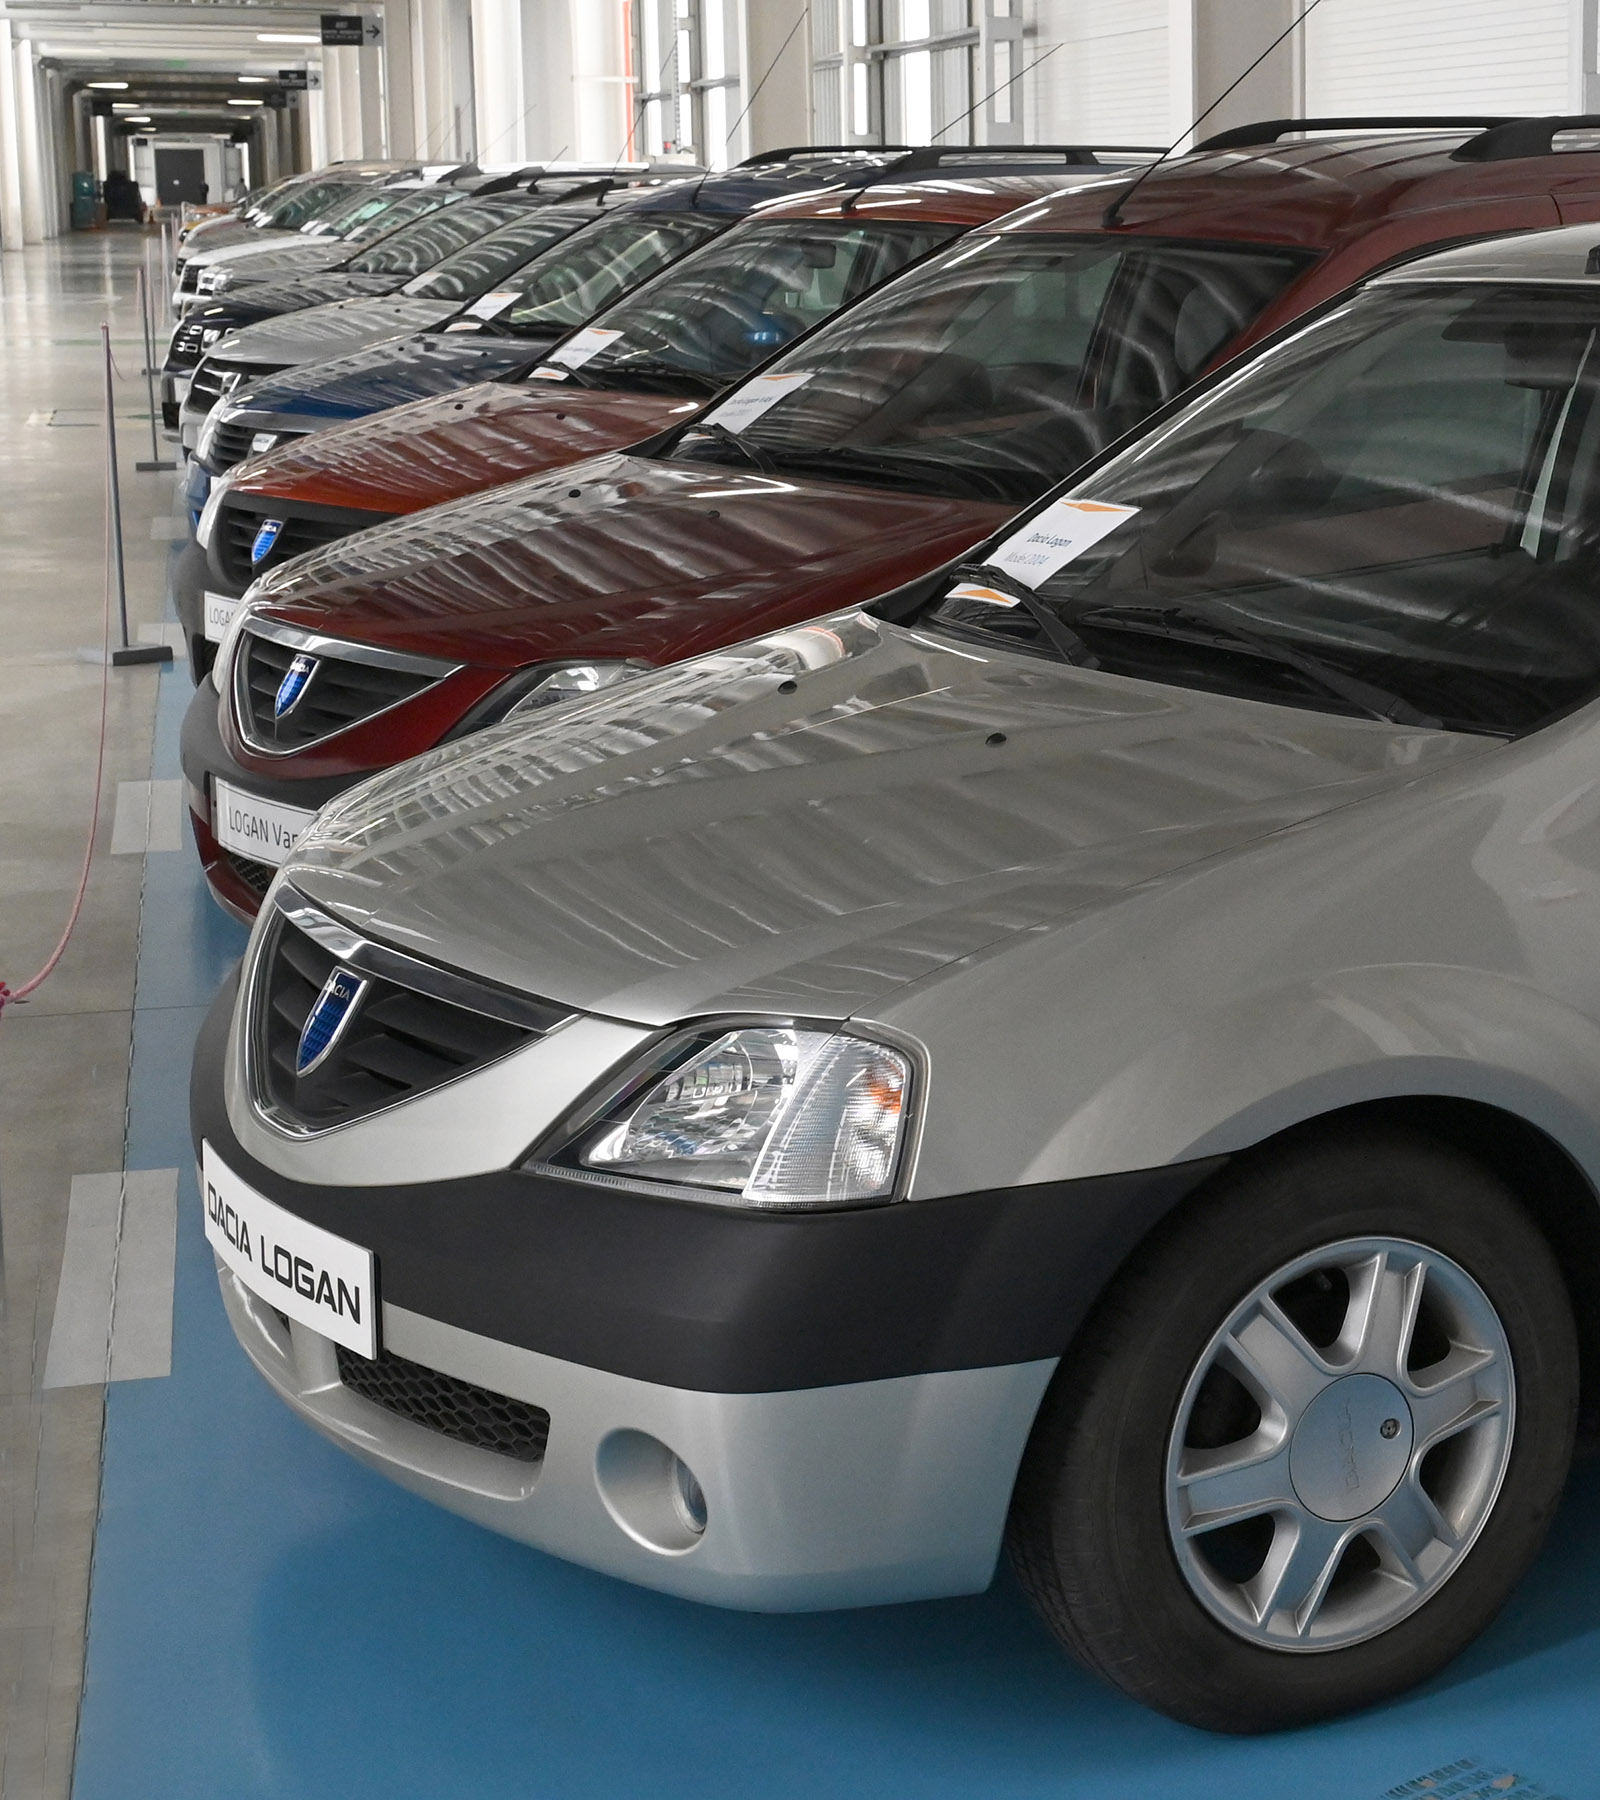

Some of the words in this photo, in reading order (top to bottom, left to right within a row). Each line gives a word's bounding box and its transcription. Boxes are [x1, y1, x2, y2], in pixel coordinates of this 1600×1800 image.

[1046, 534, 1073, 549] Logan
[229, 805, 269, 844] LOGAN
[207, 1180, 253, 1263] DACIA
[260, 1234, 361, 1326] LOGAN
